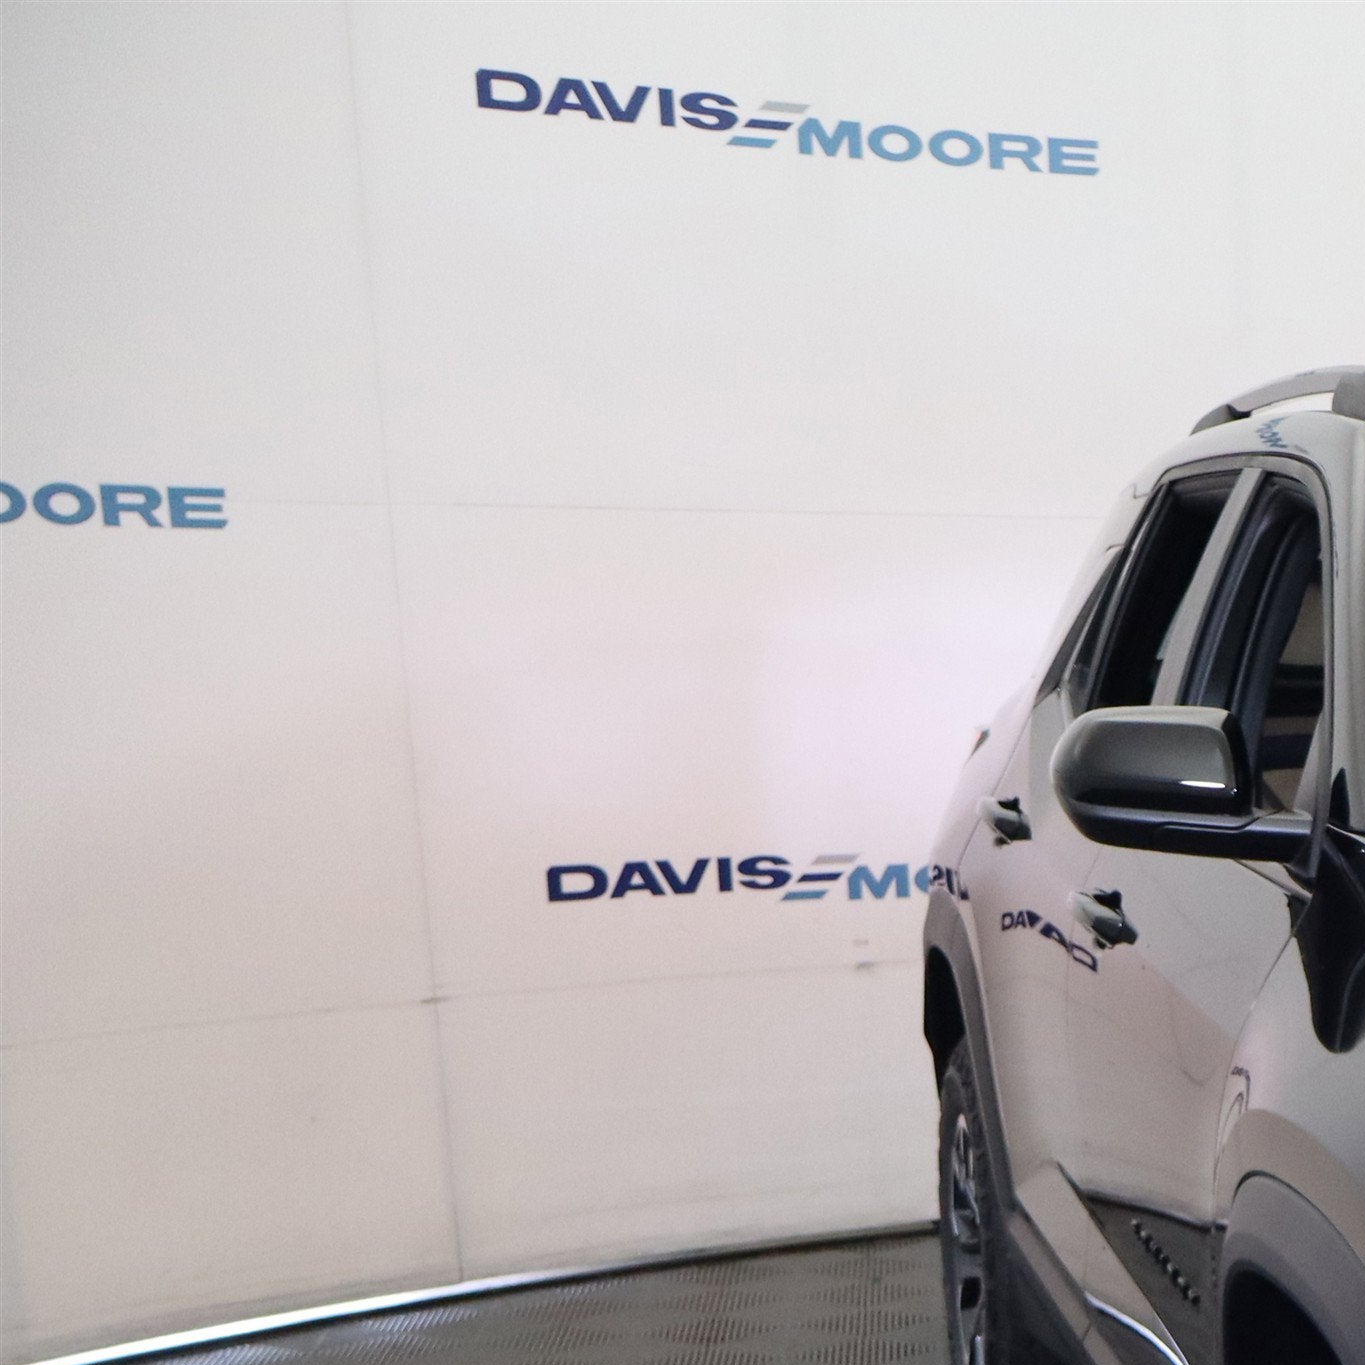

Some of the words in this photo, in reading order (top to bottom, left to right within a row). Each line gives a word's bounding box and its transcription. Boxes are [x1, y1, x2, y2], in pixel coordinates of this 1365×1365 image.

[475, 68, 739, 132] DAVIS
[797, 118, 1099, 176] MOORE
[546, 855, 793, 903] DAVIS
